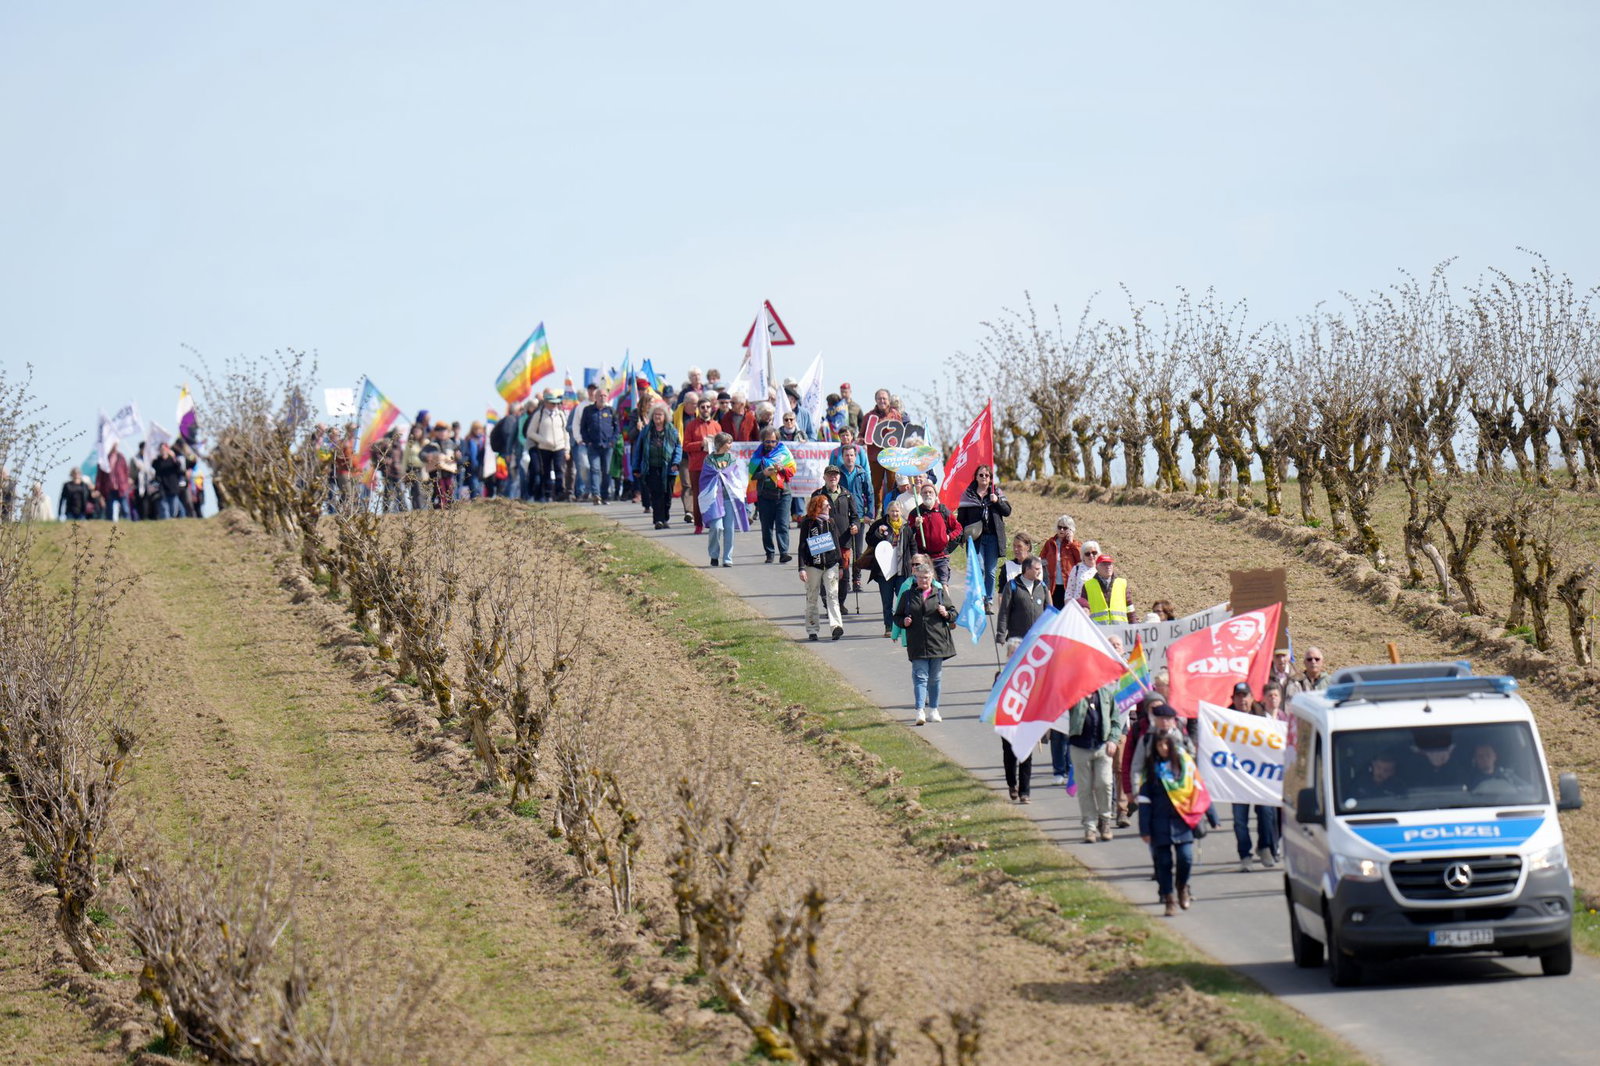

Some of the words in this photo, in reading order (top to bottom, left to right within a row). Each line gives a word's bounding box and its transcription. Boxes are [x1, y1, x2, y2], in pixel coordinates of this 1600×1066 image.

[790, 449, 832, 460] EGINNT
[1190, 613, 1212, 632] OUT
[1002, 638, 1054, 722] DGB
[1212, 720, 1283, 750] unse
[1211, 751, 1284, 781] atom
[1403, 825, 1500, 842] POLIZEI
